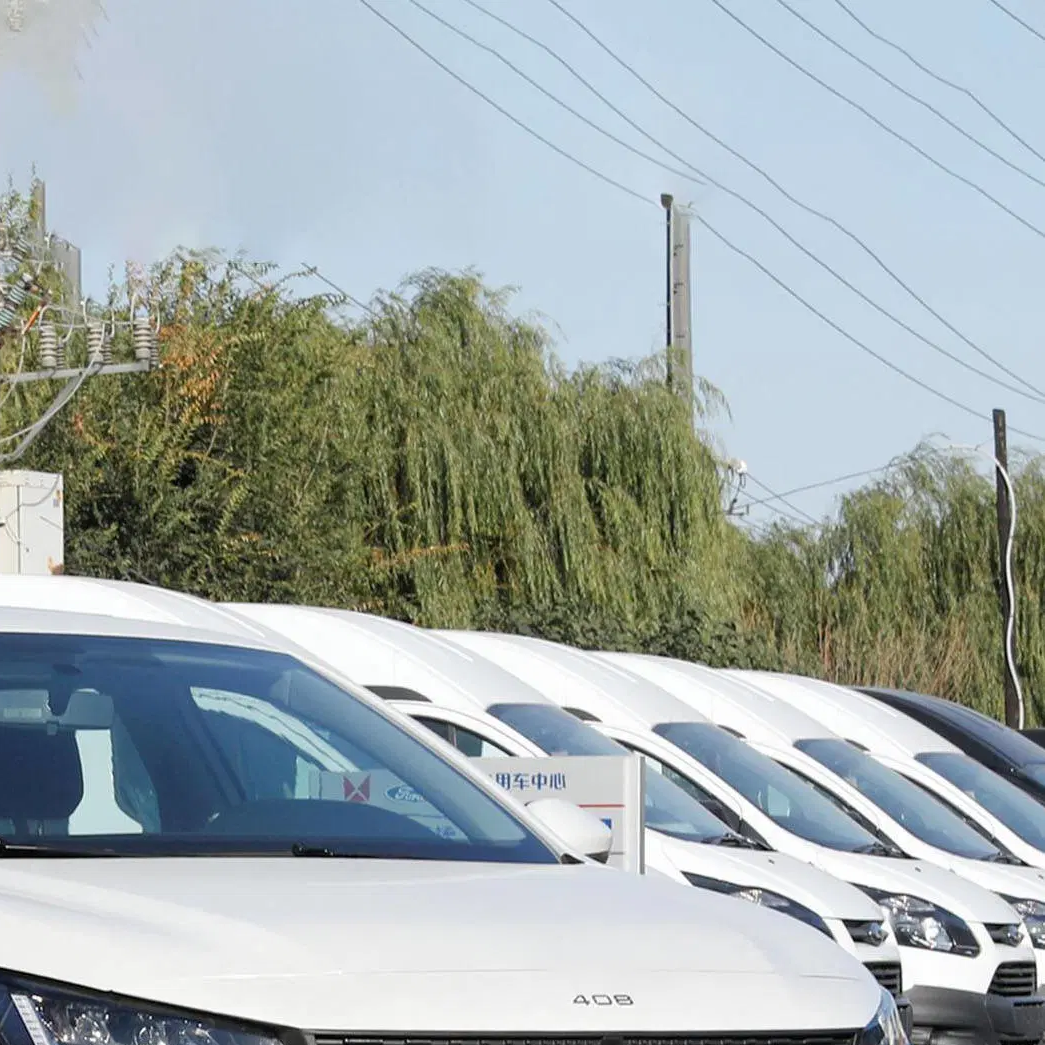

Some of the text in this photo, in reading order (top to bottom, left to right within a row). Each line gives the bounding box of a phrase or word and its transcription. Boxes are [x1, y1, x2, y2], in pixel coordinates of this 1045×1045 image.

[489, 772, 566, 790] 用车中心
[573, 994, 634, 1005] 408
